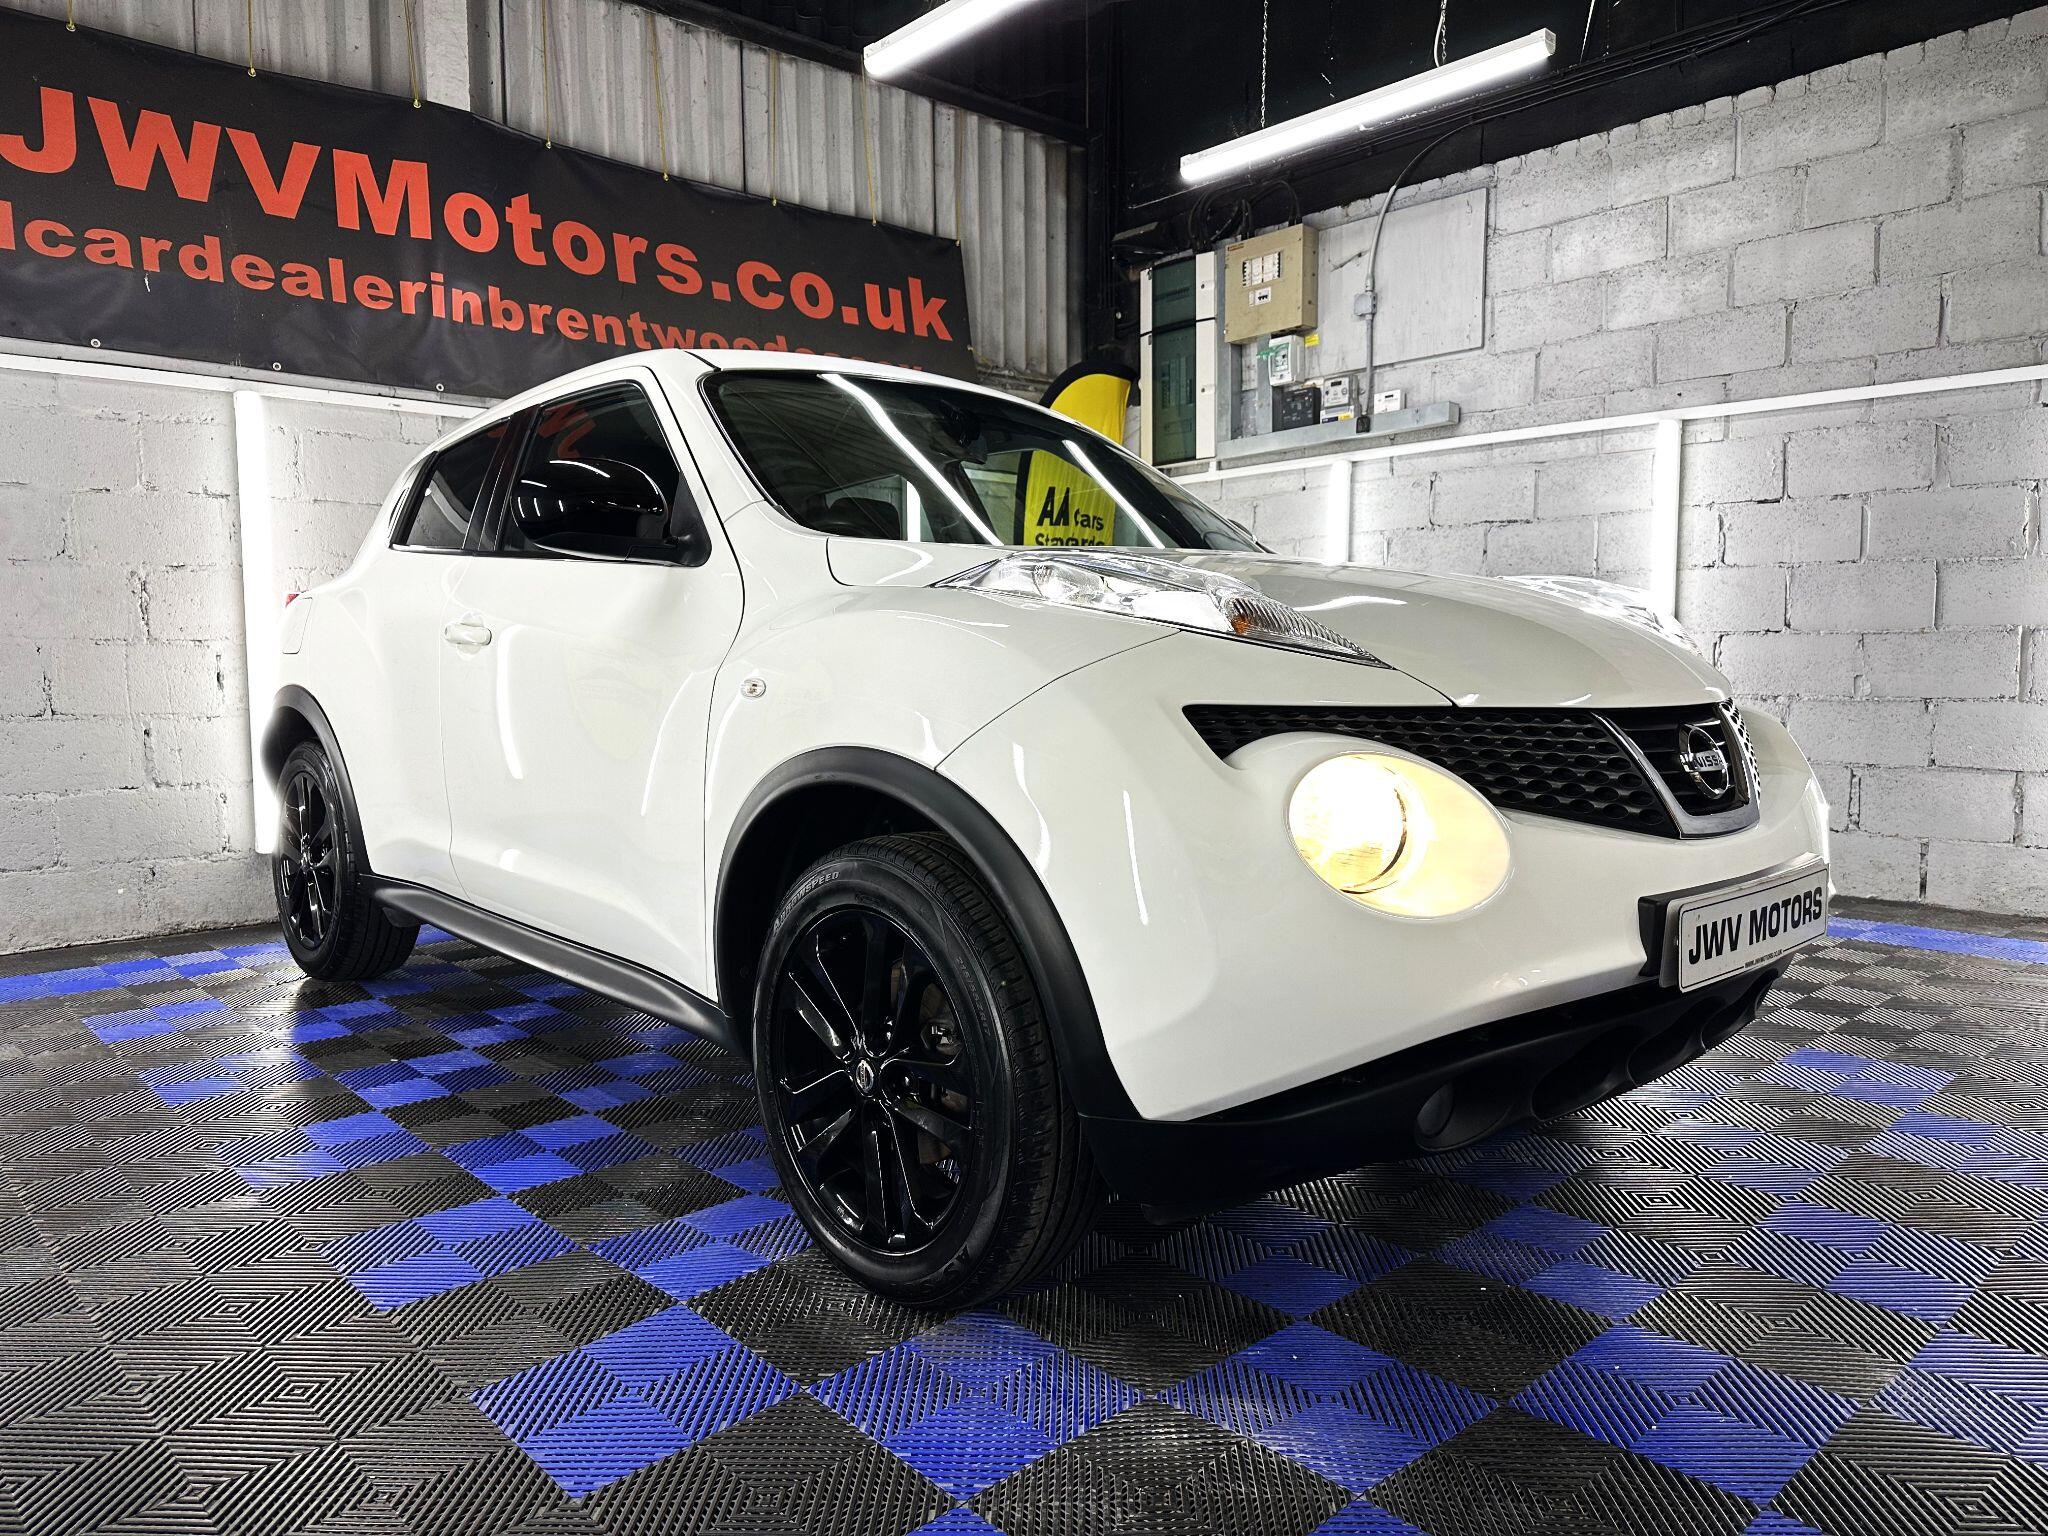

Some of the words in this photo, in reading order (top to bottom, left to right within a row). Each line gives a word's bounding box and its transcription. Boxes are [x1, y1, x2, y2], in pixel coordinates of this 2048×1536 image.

[1036, 486, 1071, 527] AA
[1688, 913, 1742, 966] JWV
[1749, 886, 1823, 946] MOTORS
